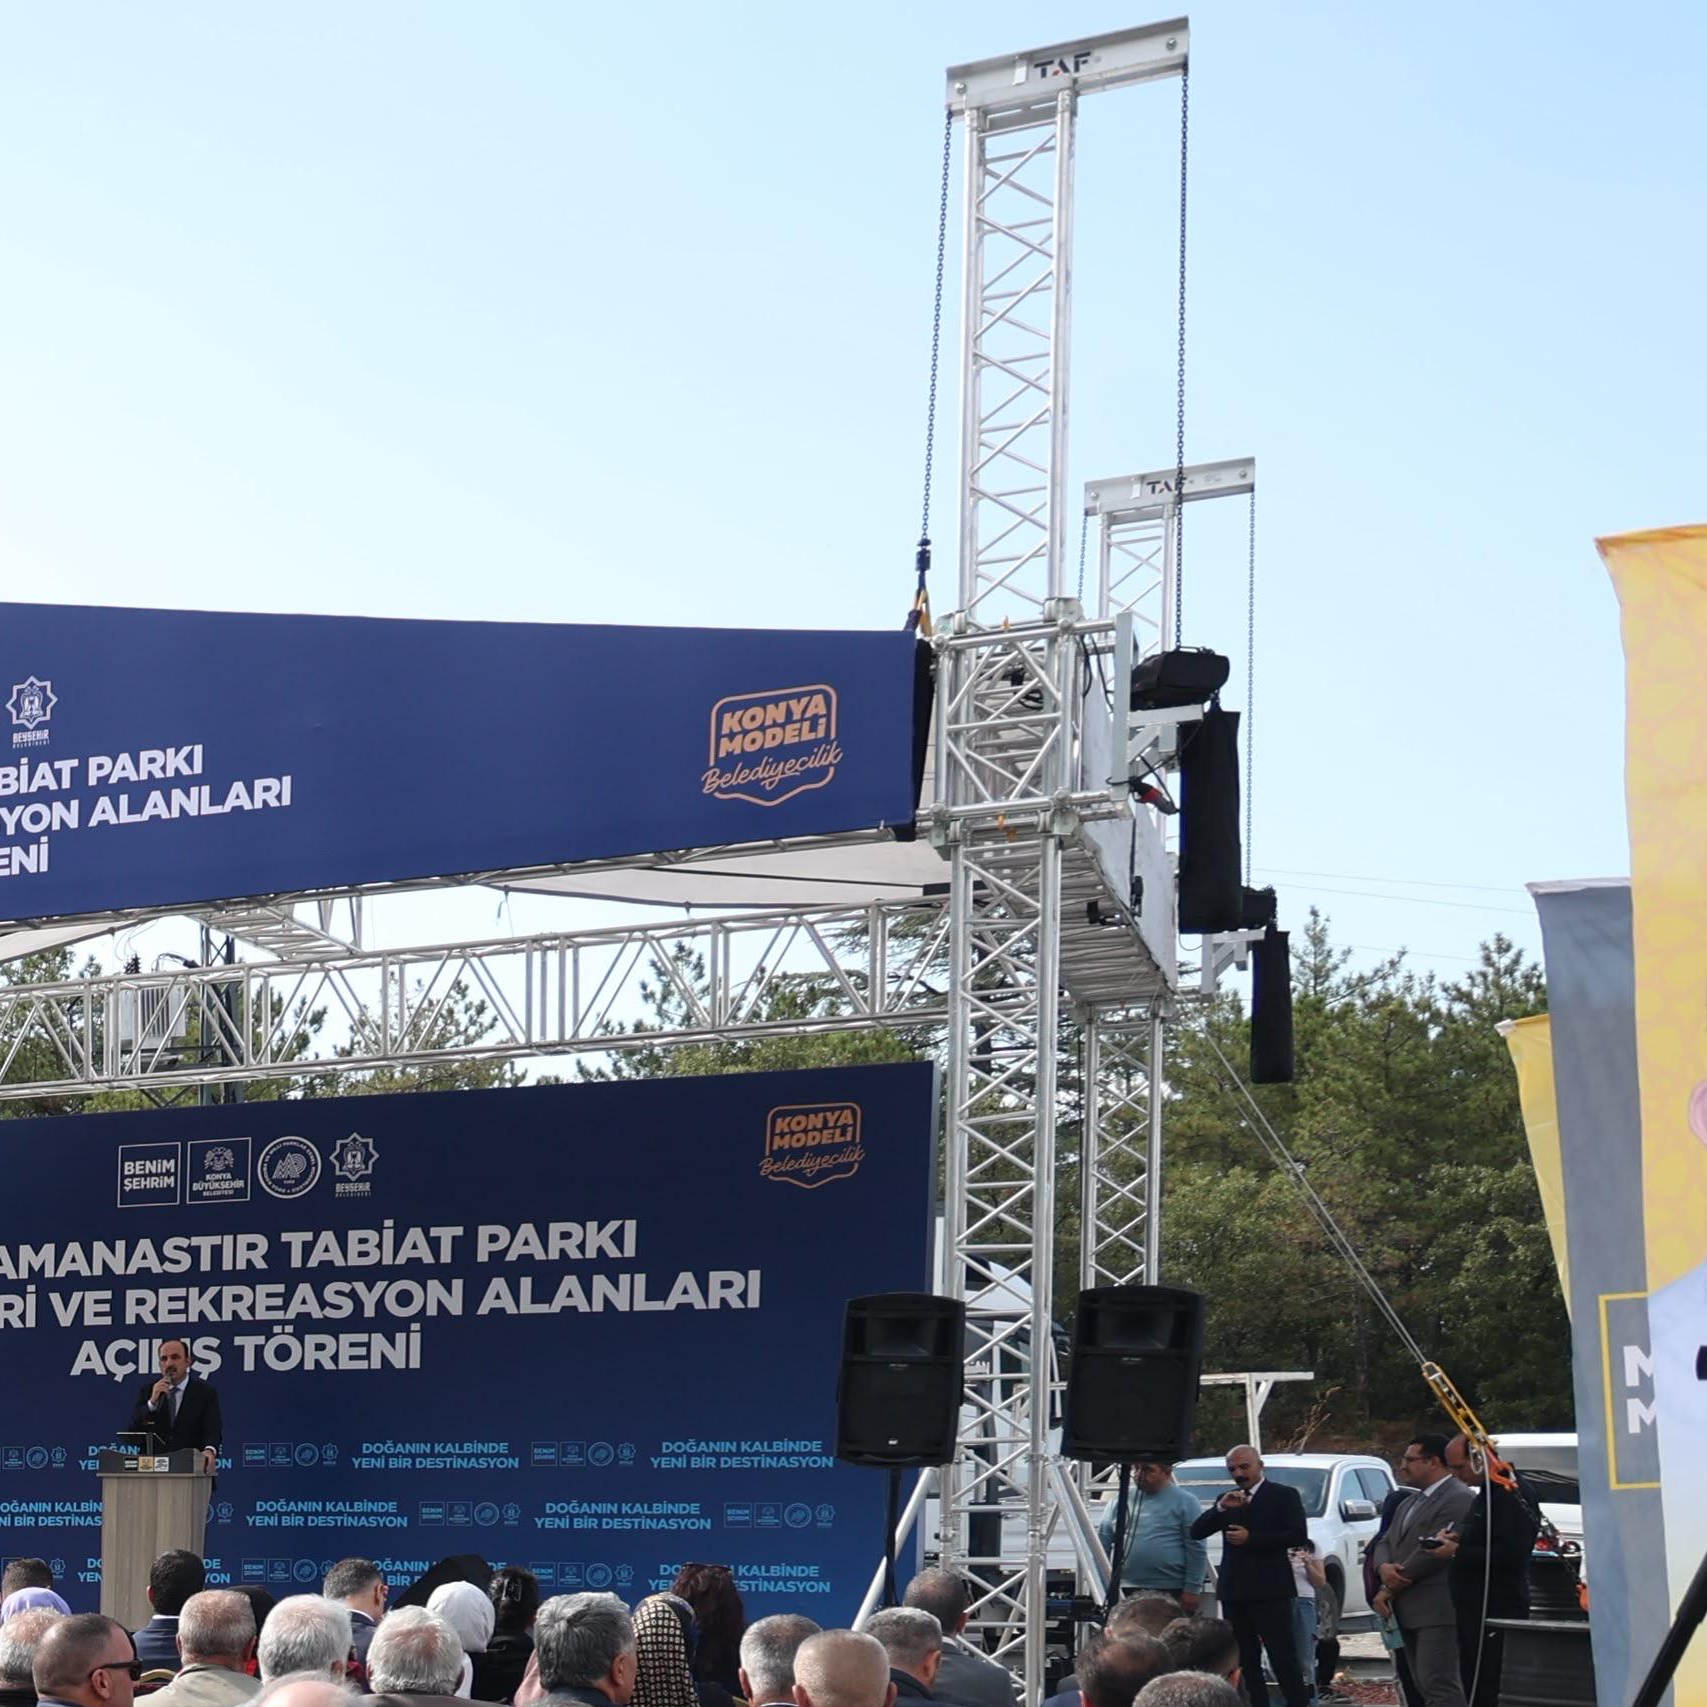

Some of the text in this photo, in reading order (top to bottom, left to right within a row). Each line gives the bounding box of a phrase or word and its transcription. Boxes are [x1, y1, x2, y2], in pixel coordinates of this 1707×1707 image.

[722, 694, 827, 734] KONYA
[88, 744, 202, 786] PARKI
[701, 741, 843, 794] Belediyecilik
[88, 775, 292, 828] ALANLARI
[774, 1108, 853, 1134] KONYA
[759, 1144, 865, 1177] Belediyecilik
[205, 1172, 232, 1181] KONYA
[281, 1220, 463, 1268] TABİAT
[477, 1220, 636, 1262] PARKI
[49, 1290, 112, 1326] VE
[125, 1279, 463, 1324] REKREASYON
[477, 1270, 760, 1314] ALANLARI
[234, 1323, 421, 1371] TÖRENİ
[363, 1440, 508, 1454] DOĞANIN KALBİNDE
[662, 1438, 822, 1453] DOĞANIN KALBİNDE
[352, 1455, 519, 1468] YENİ BİR DESTİNASYON
[651, 1454, 833, 1468] YENİ BİR DESTİNASYON
[54, 1500, 102, 1513] KALBİN
[257, 1499, 397, 1512] DOĞANIN KALBİNDE
[546, 1500, 700, 1514] DOĞANIN KALBİNDE
[15, 1514, 35, 1526] BİR
[38, 1515, 102, 1528] DESTİNAS
[247, 1514, 407, 1527] YENİ BİR DESTİNASYON
[535, 1515, 711, 1529] YENİ BİR DESTİNASYON
[739, 1563, 819, 1577] KALBİNDE
